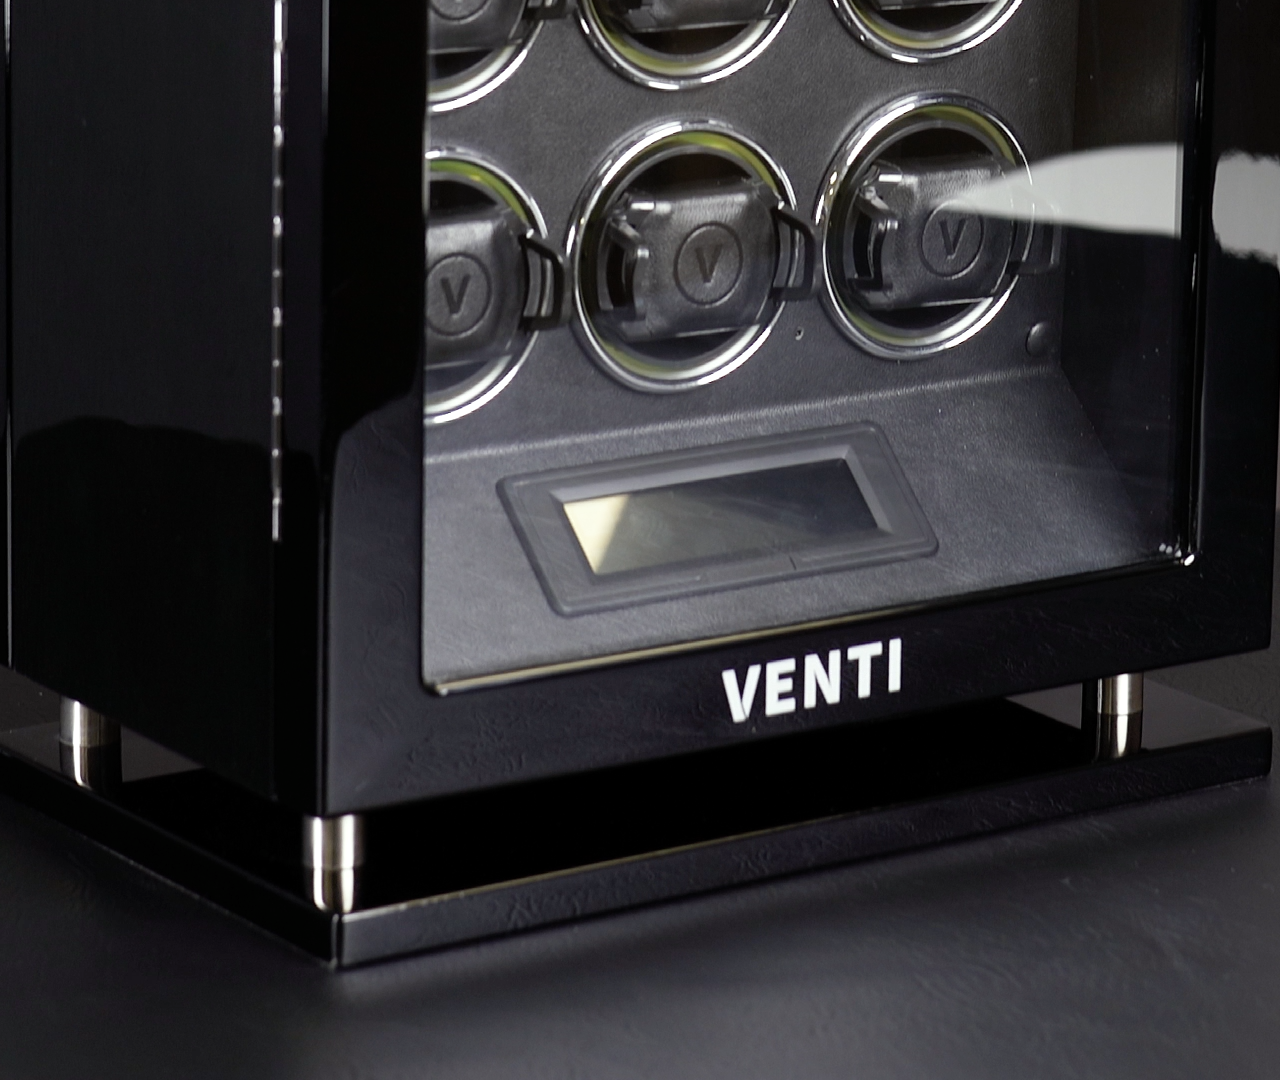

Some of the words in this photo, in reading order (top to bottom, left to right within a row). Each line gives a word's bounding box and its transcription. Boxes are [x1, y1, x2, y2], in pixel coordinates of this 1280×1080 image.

[940, 221, 966, 259] V
[696, 244, 722, 284] V
[440, 275, 470, 318] V
[722, 638, 901, 723] VENTI
